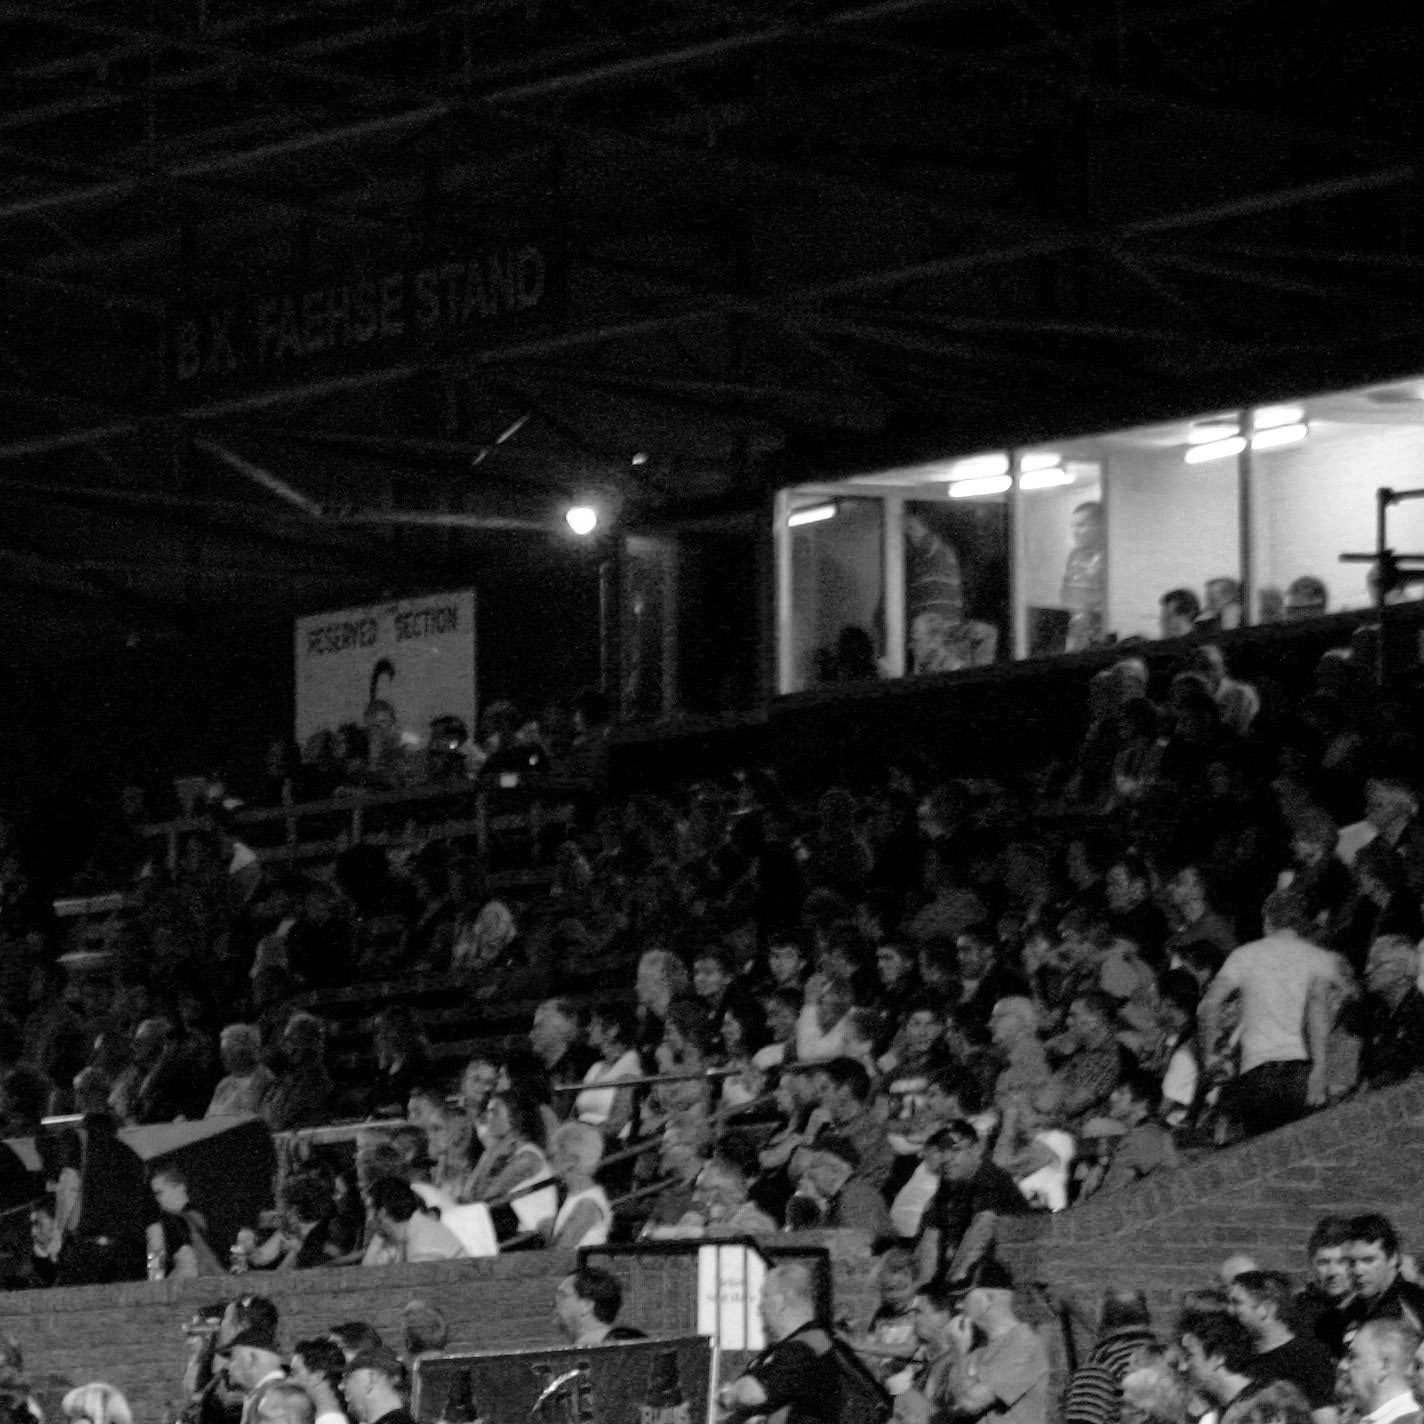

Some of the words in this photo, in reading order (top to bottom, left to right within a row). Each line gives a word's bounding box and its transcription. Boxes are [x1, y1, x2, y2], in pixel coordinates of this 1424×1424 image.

[414, 245, 545, 332] STAND
[308, 617, 378, 655] RESERVED
[393, 606, 459, 643] SECTION
